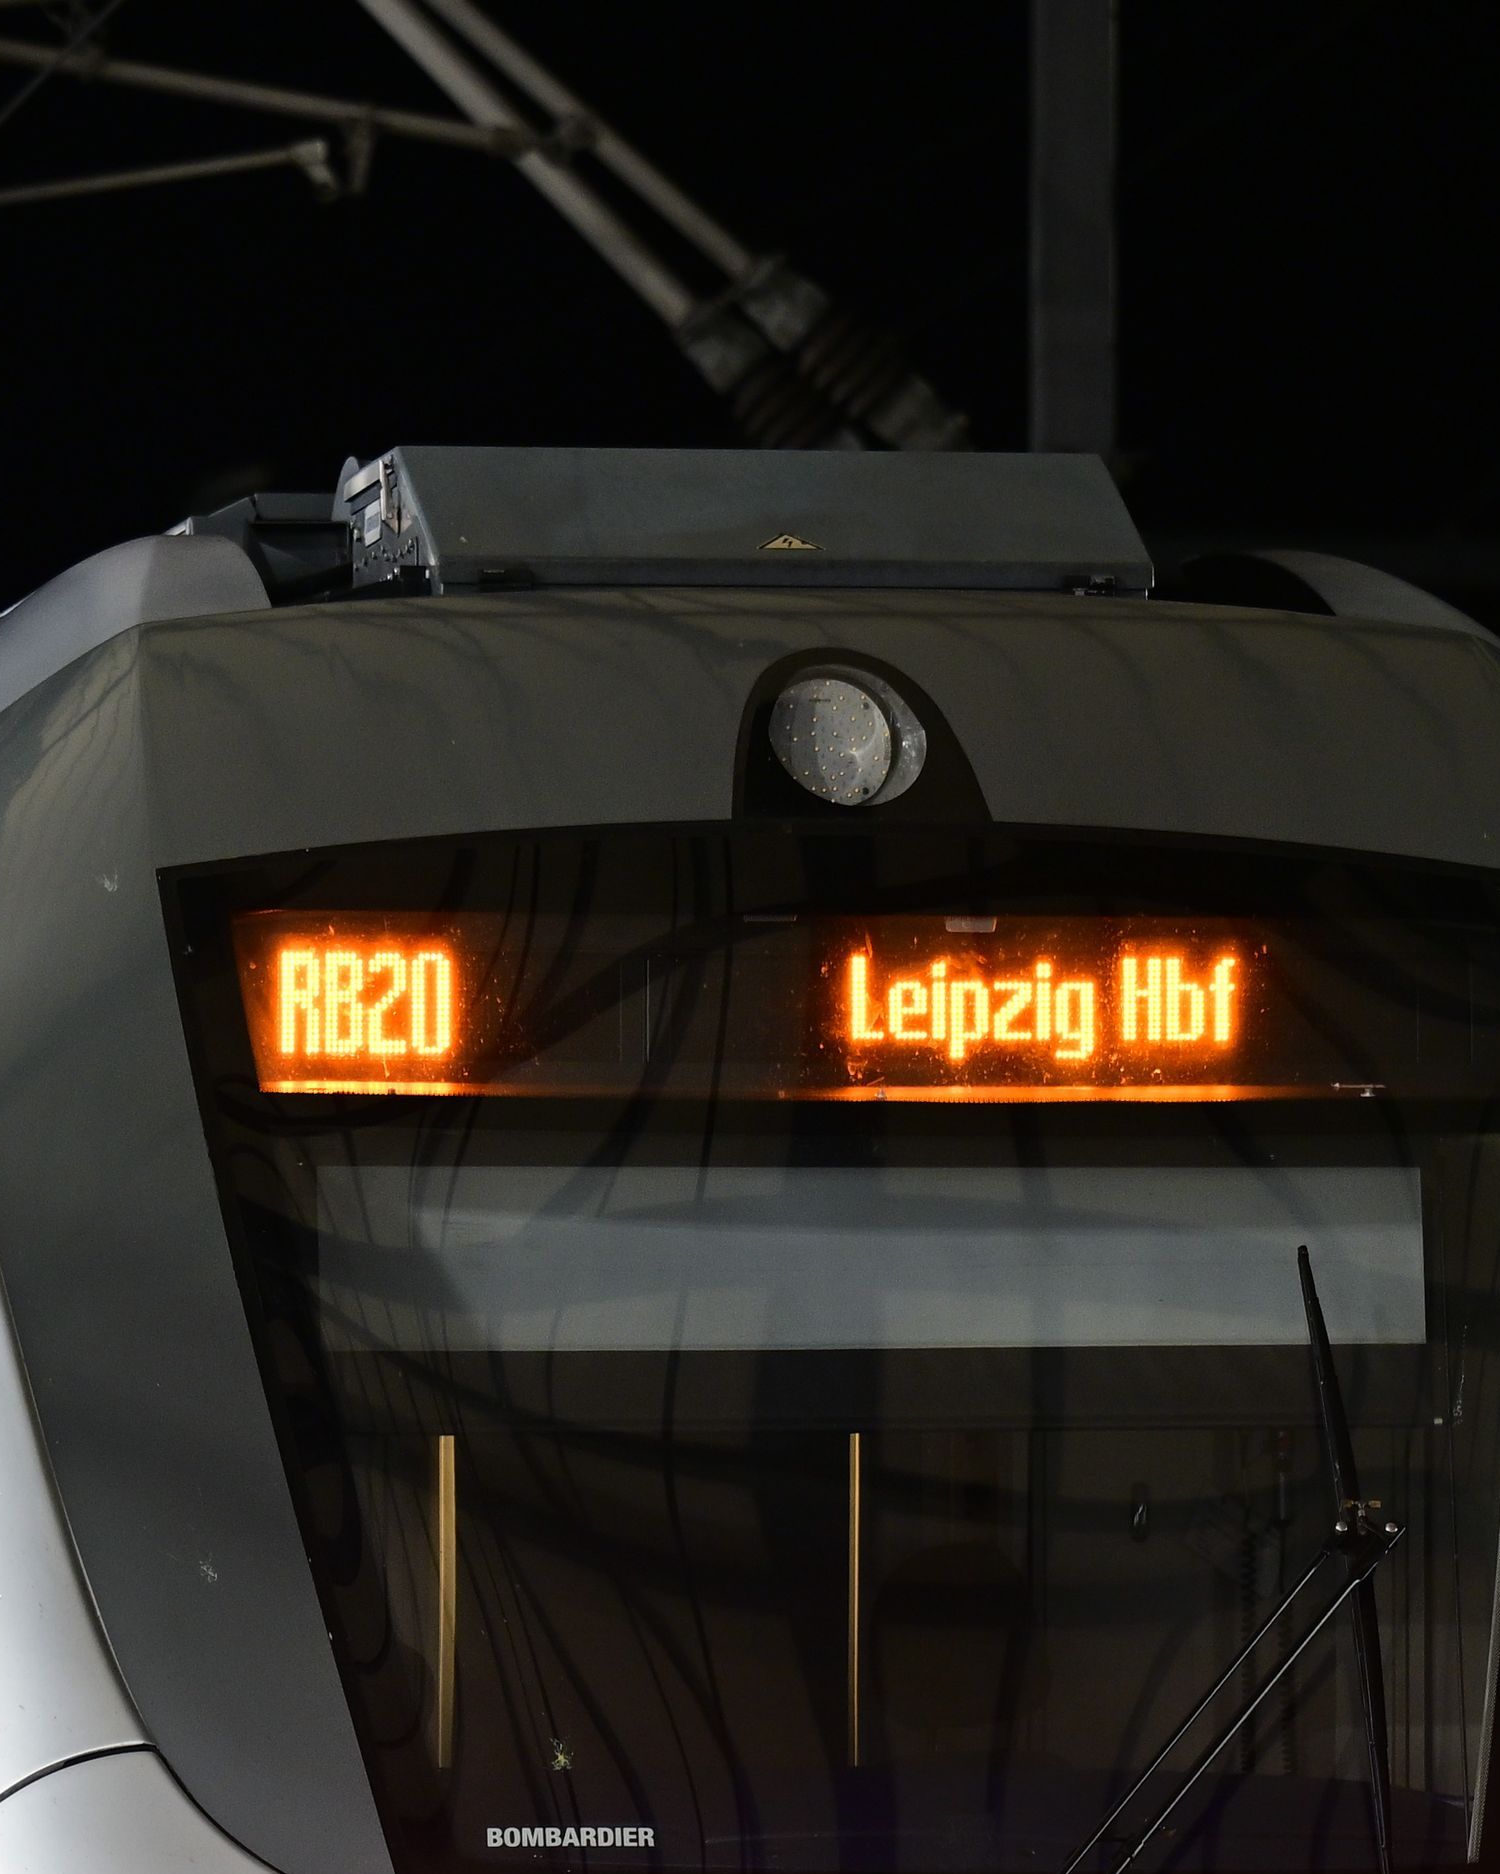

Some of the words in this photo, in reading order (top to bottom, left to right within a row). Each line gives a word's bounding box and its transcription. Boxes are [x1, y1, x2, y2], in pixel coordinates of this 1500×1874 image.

[280, 948, 451, 1056] RB20
[851, 956, 1095, 1060] Leipzig
[1120, 957, 1235, 1043] Hbf
[486, 1827, 655, 1848] BOMBARDIER
